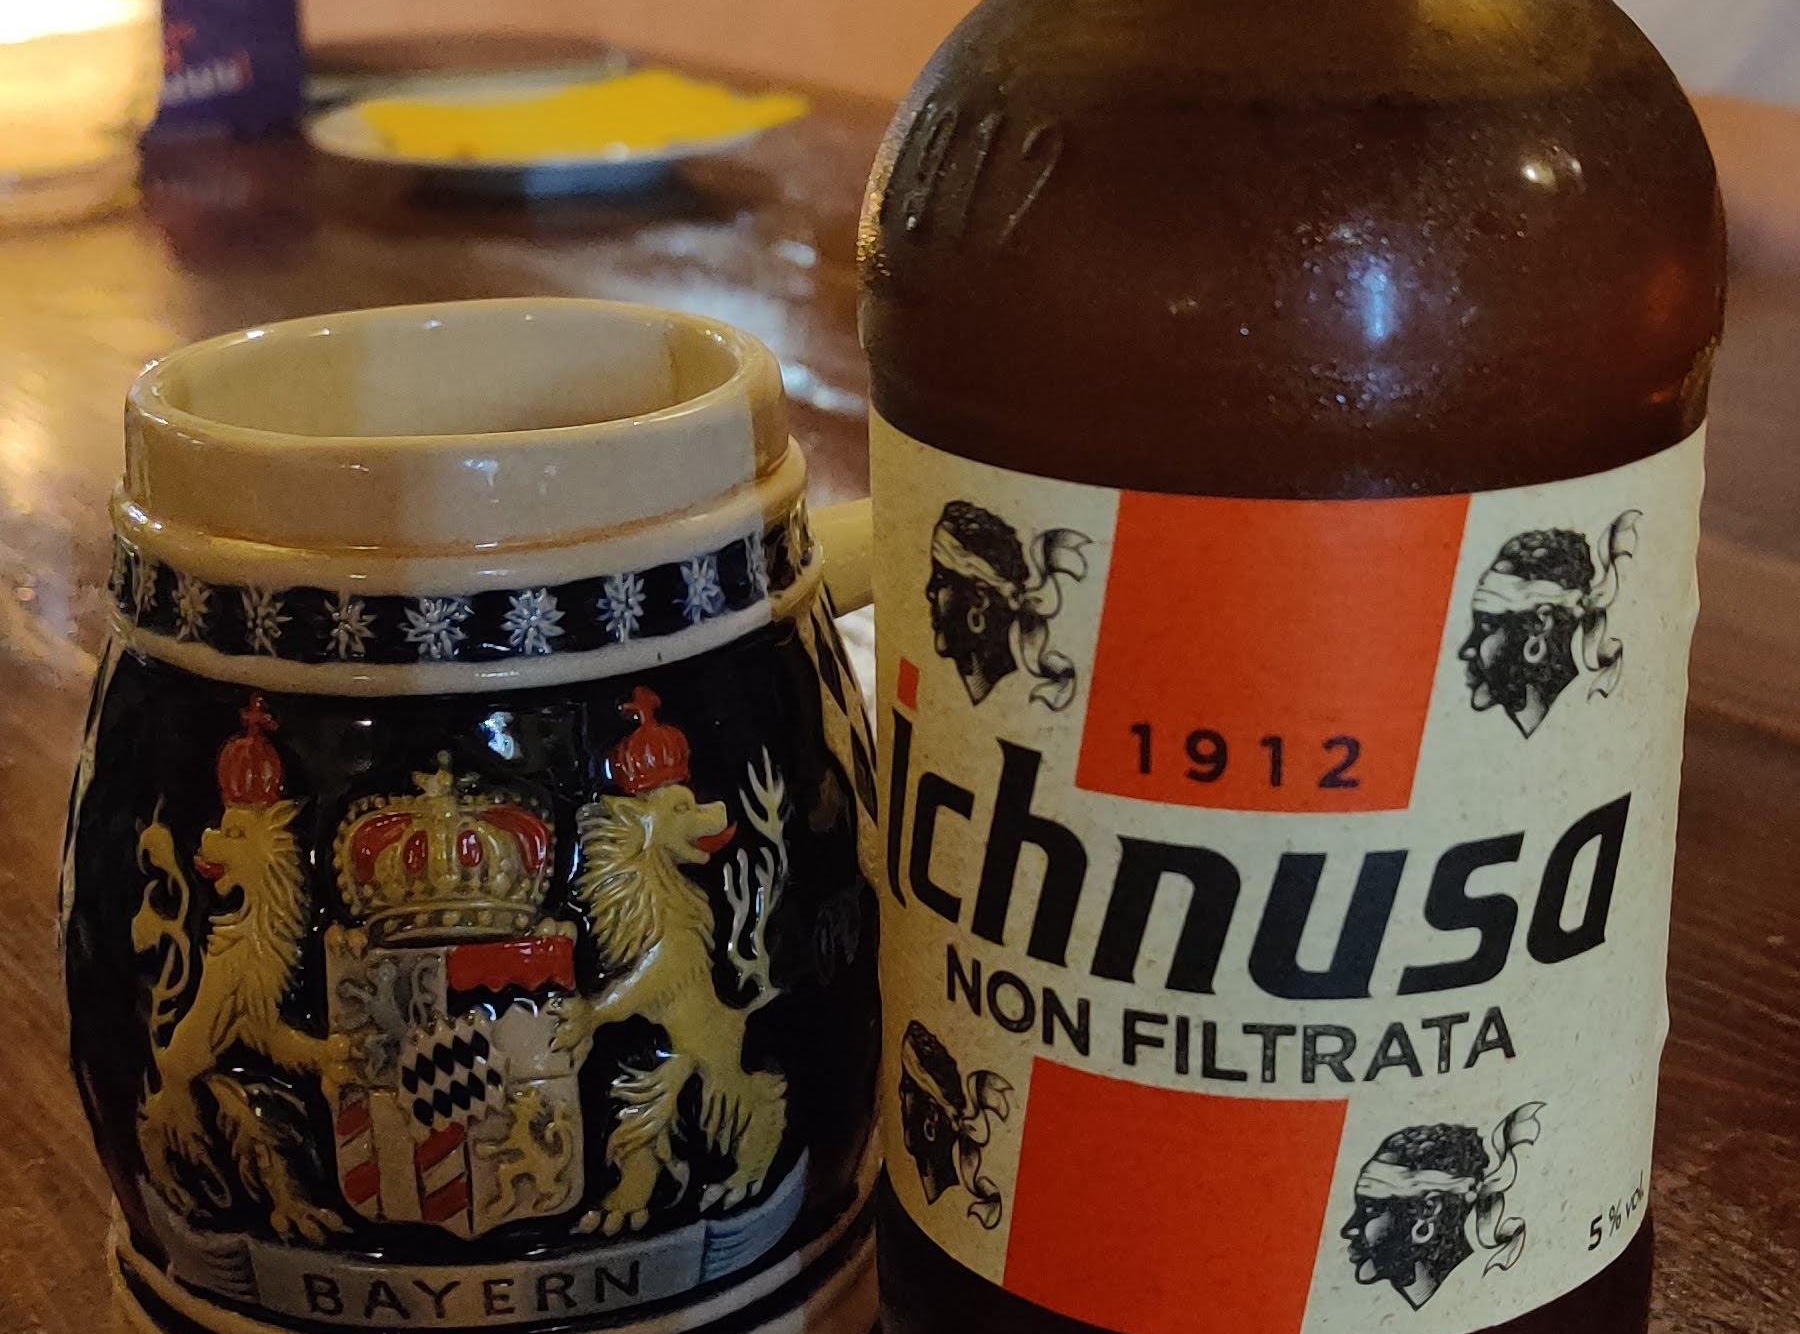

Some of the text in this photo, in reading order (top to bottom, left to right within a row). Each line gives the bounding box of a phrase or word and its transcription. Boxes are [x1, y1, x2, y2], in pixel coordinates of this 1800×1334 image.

[1131, 722, 1361, 789] 1912
[888, 659, 1632, 1000] ichnusa
[946, 943, 1516, 1084] NON FILTRATA
[303, 1260, 640, 1320] BAYERN
